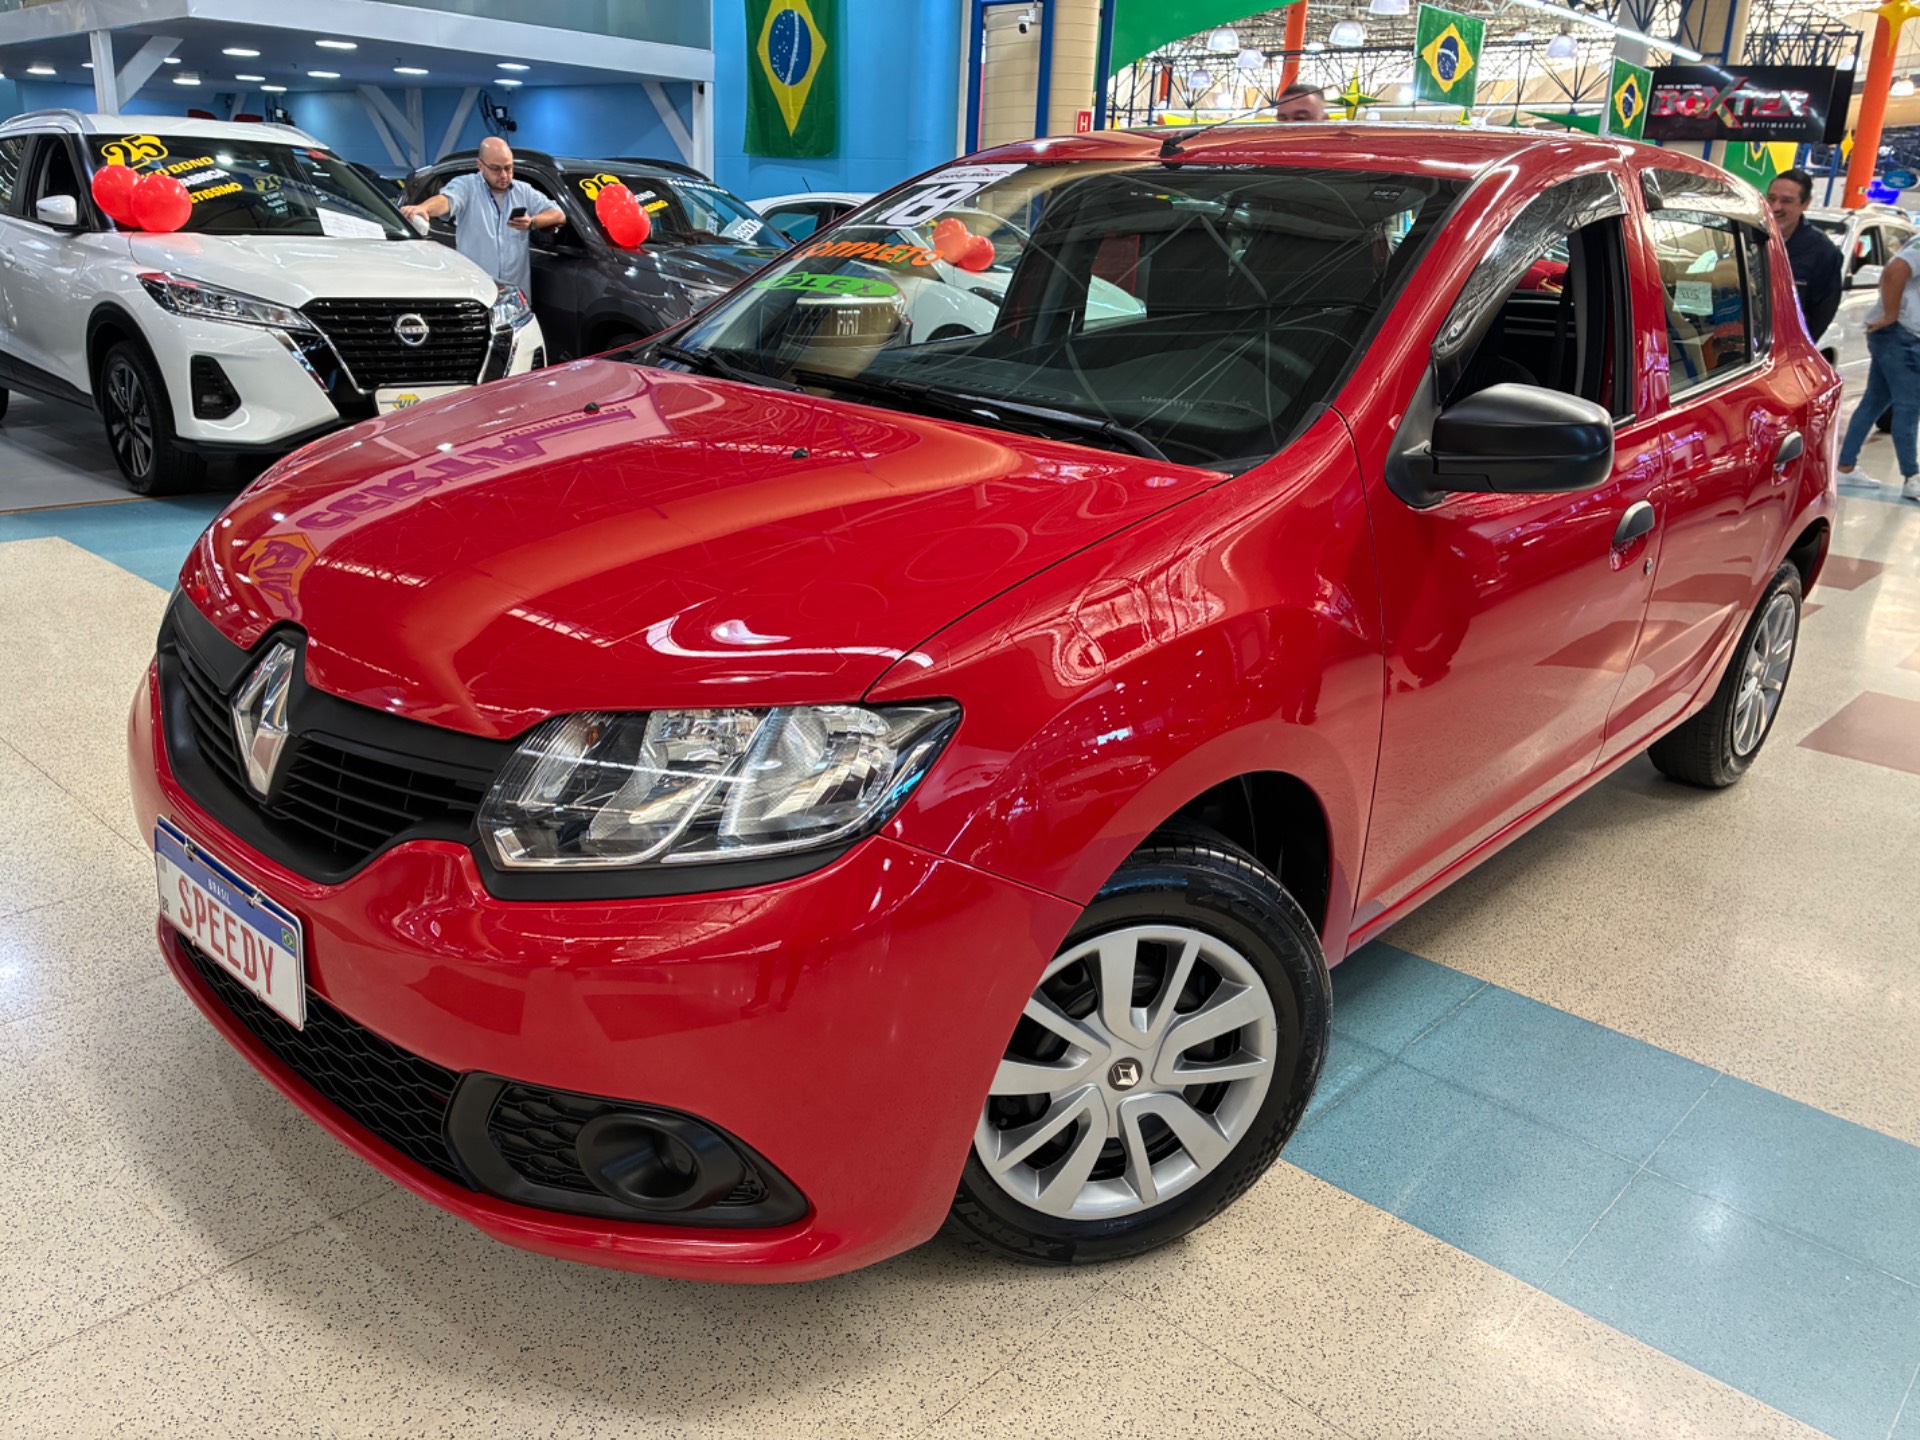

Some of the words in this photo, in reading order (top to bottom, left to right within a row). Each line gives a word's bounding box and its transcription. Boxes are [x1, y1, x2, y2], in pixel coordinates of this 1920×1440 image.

[1650, 77, 1810, 128] BOXTER
[168, 156, 215, 174] DONO
[875, 183, 981, 226] 18
[791, 241, 945, 267] COMPLETO
[207, 878, 232, 906] BRASIL
[179, 875, 274, 996] SPEEDY
